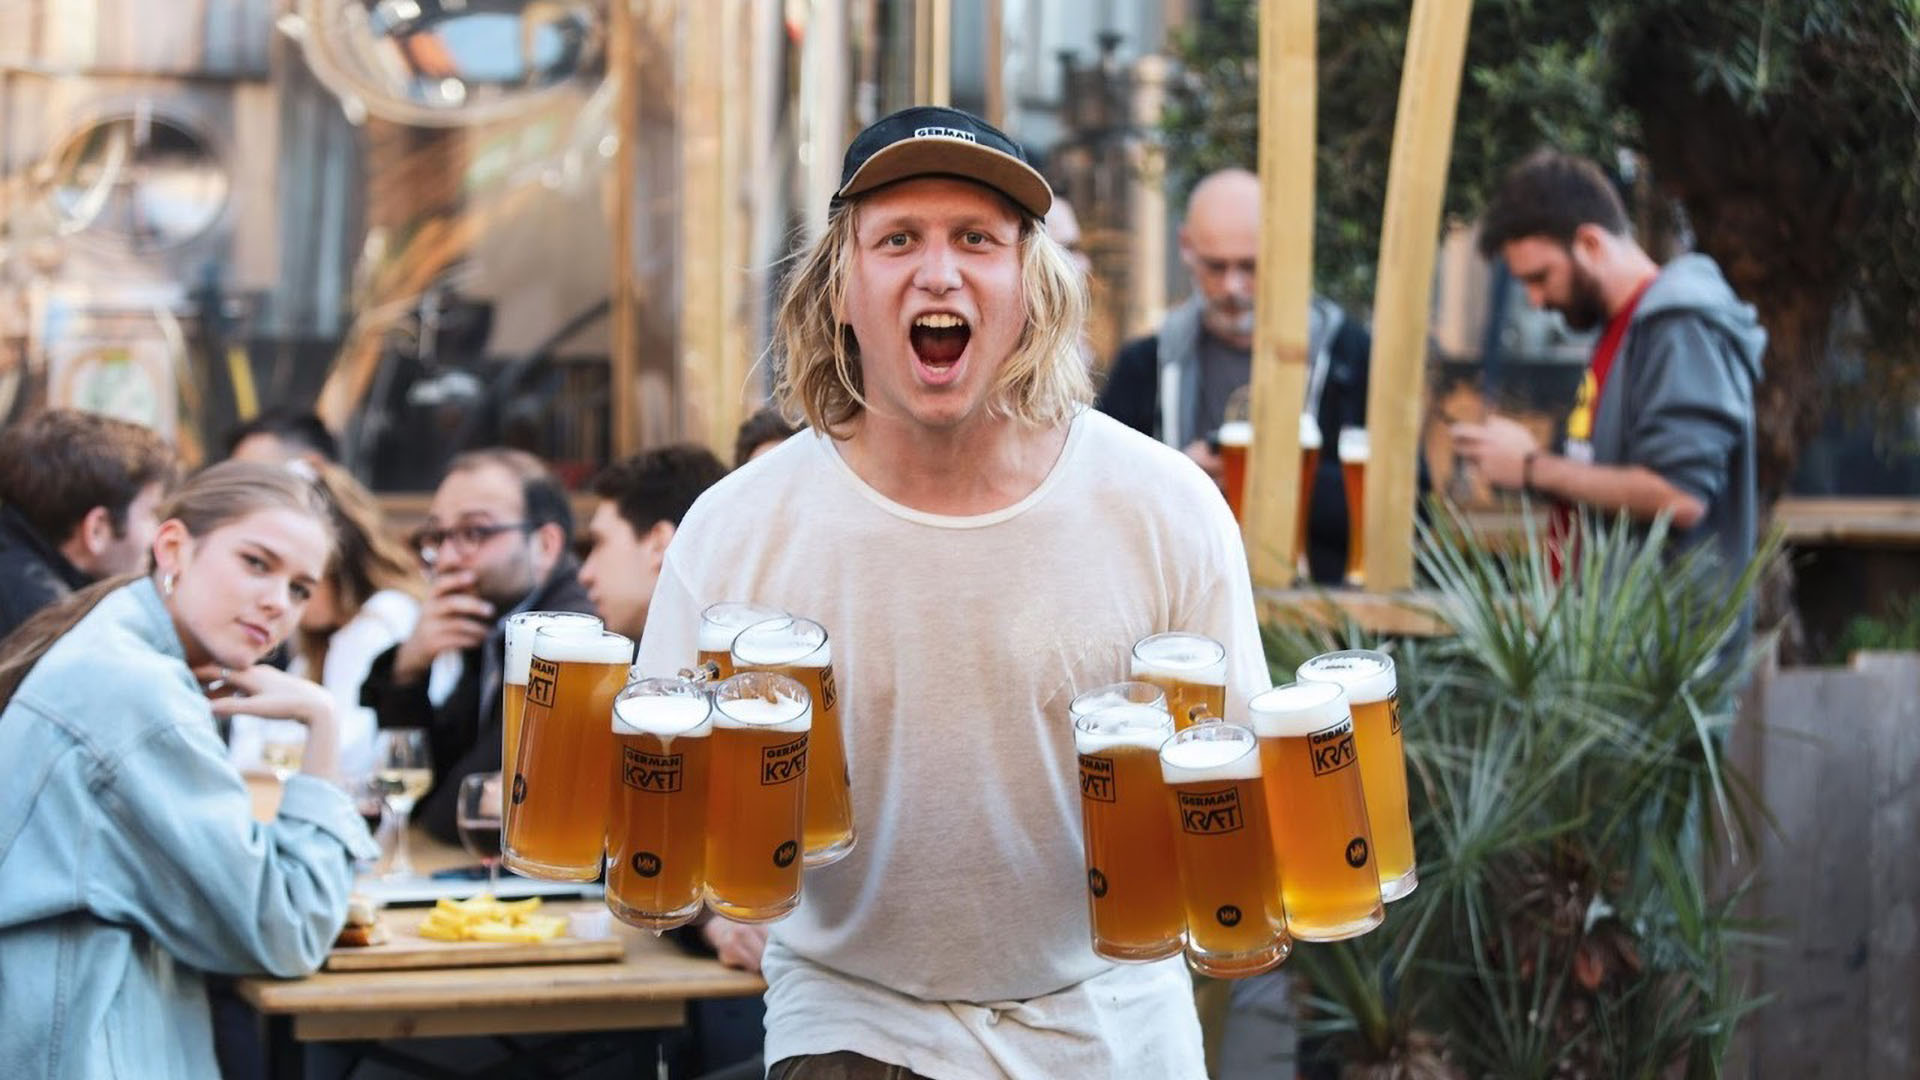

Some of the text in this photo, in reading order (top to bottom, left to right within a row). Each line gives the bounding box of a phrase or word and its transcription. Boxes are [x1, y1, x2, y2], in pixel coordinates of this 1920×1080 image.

[917, 128, 974, 142] GERMAN
[1312, 722, 1351, 744] GERMA
[766, 736, 808, 758] GERMA
[625, 751, 680, 767] GERMAN
[626, 763, 679, 790] KRAFT
[1181, 791, 1236, 806] GERMAN
[1183, 804, 1237, 831] KRAFT
